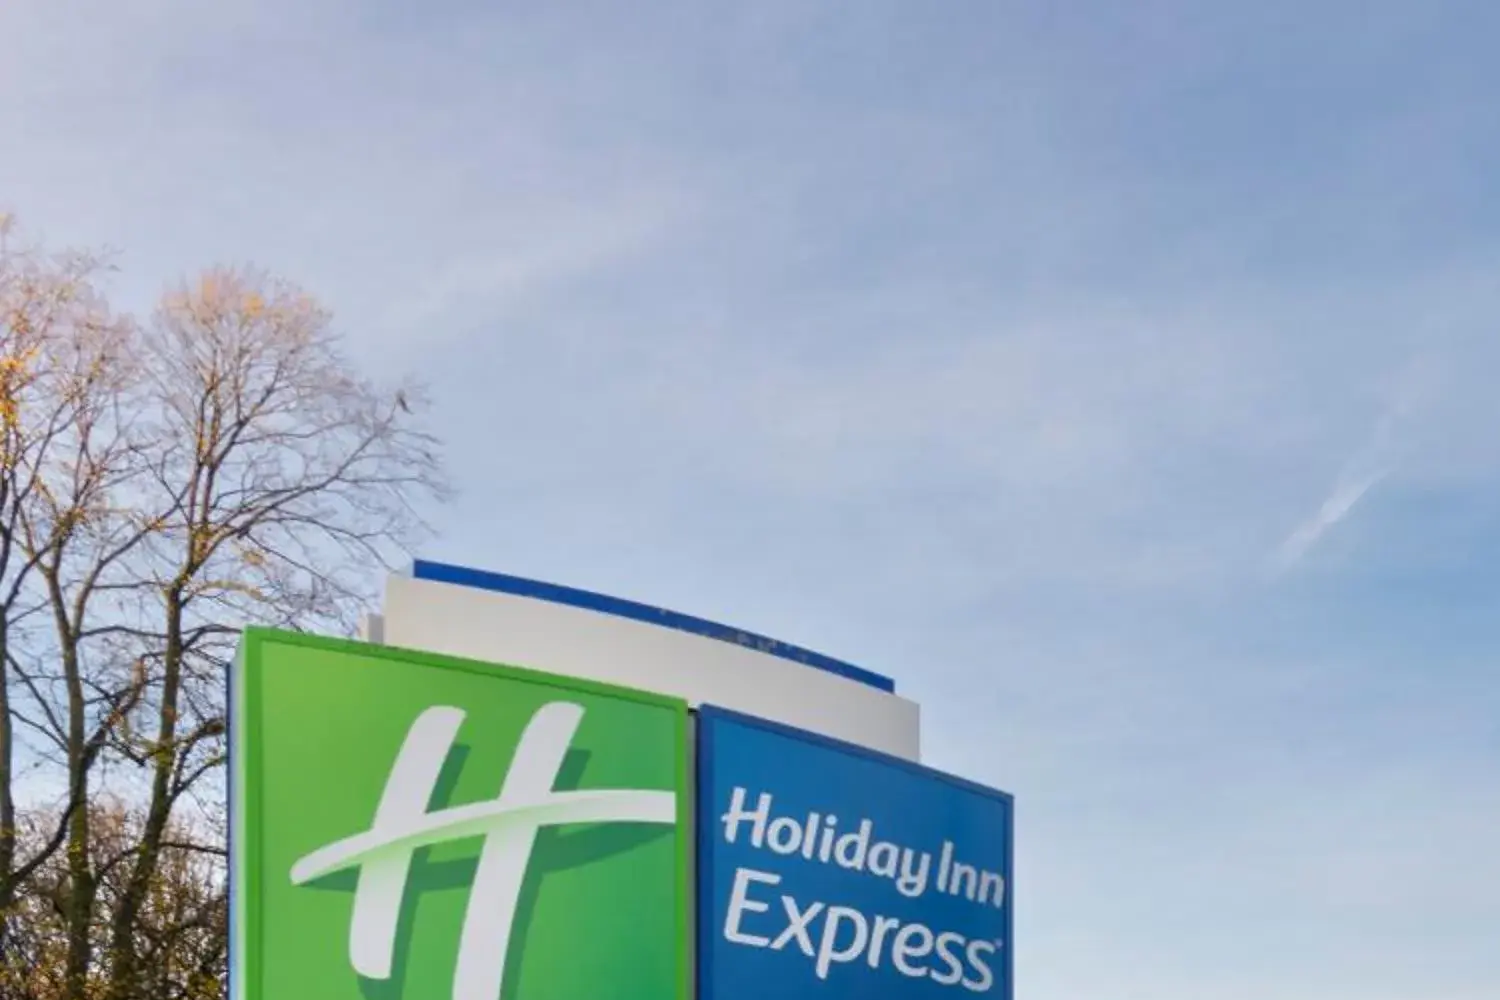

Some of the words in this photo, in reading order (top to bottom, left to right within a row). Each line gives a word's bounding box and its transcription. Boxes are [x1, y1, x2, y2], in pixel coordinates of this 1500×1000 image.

[720, 786, 931, 897] Holiday
[936, 840, 1004, 908] Inn
[723, 867, 996, 992] Express
